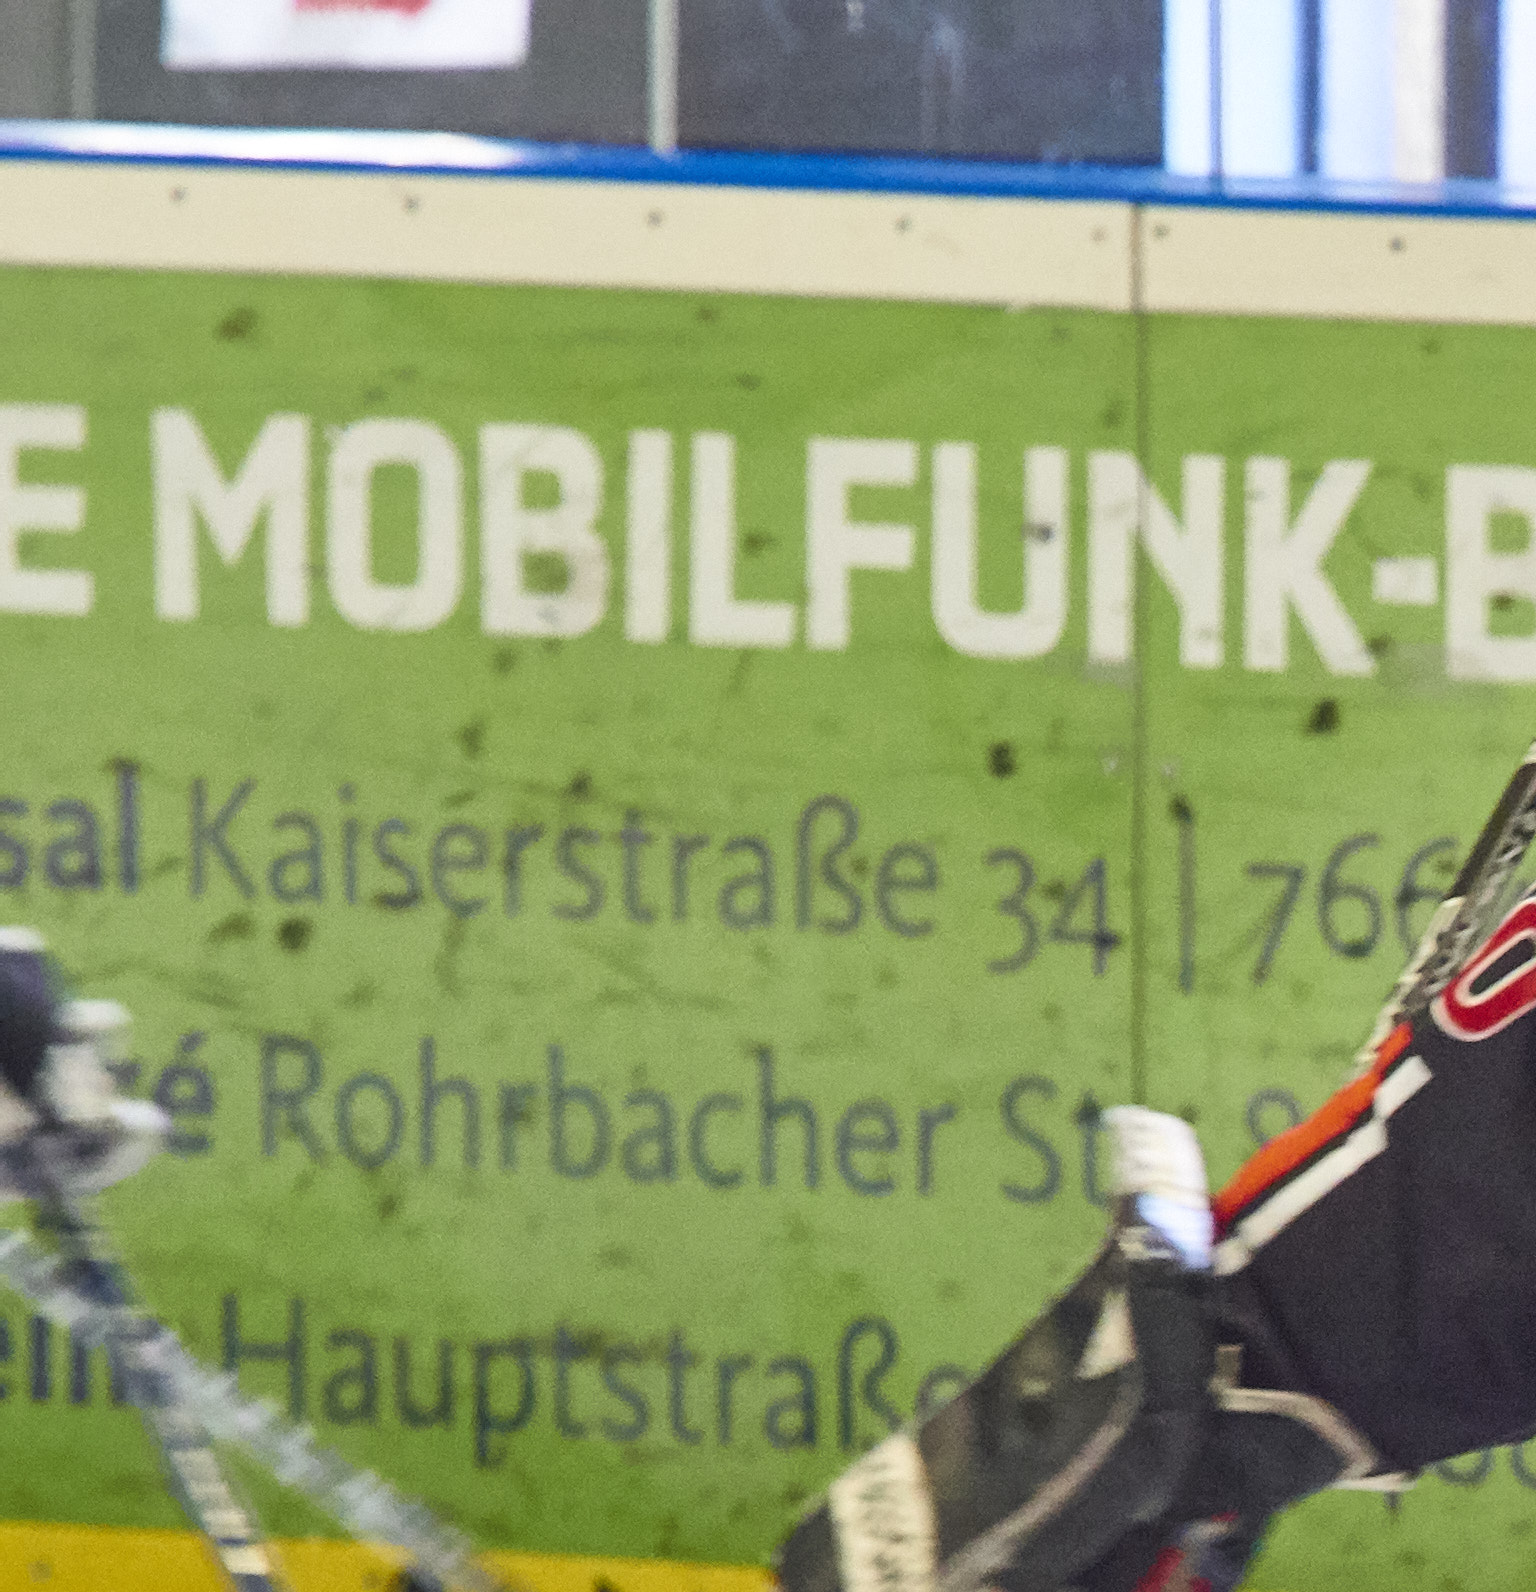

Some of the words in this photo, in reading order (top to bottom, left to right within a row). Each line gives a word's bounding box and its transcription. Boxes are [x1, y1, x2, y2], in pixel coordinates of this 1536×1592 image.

[0, 403, 95, 619] E
[189, 777, 939, 938] Kaiserstraße
[983, 847, 1121, 976] 34
[260, 1034, 956, 1196] Rohrbacher
